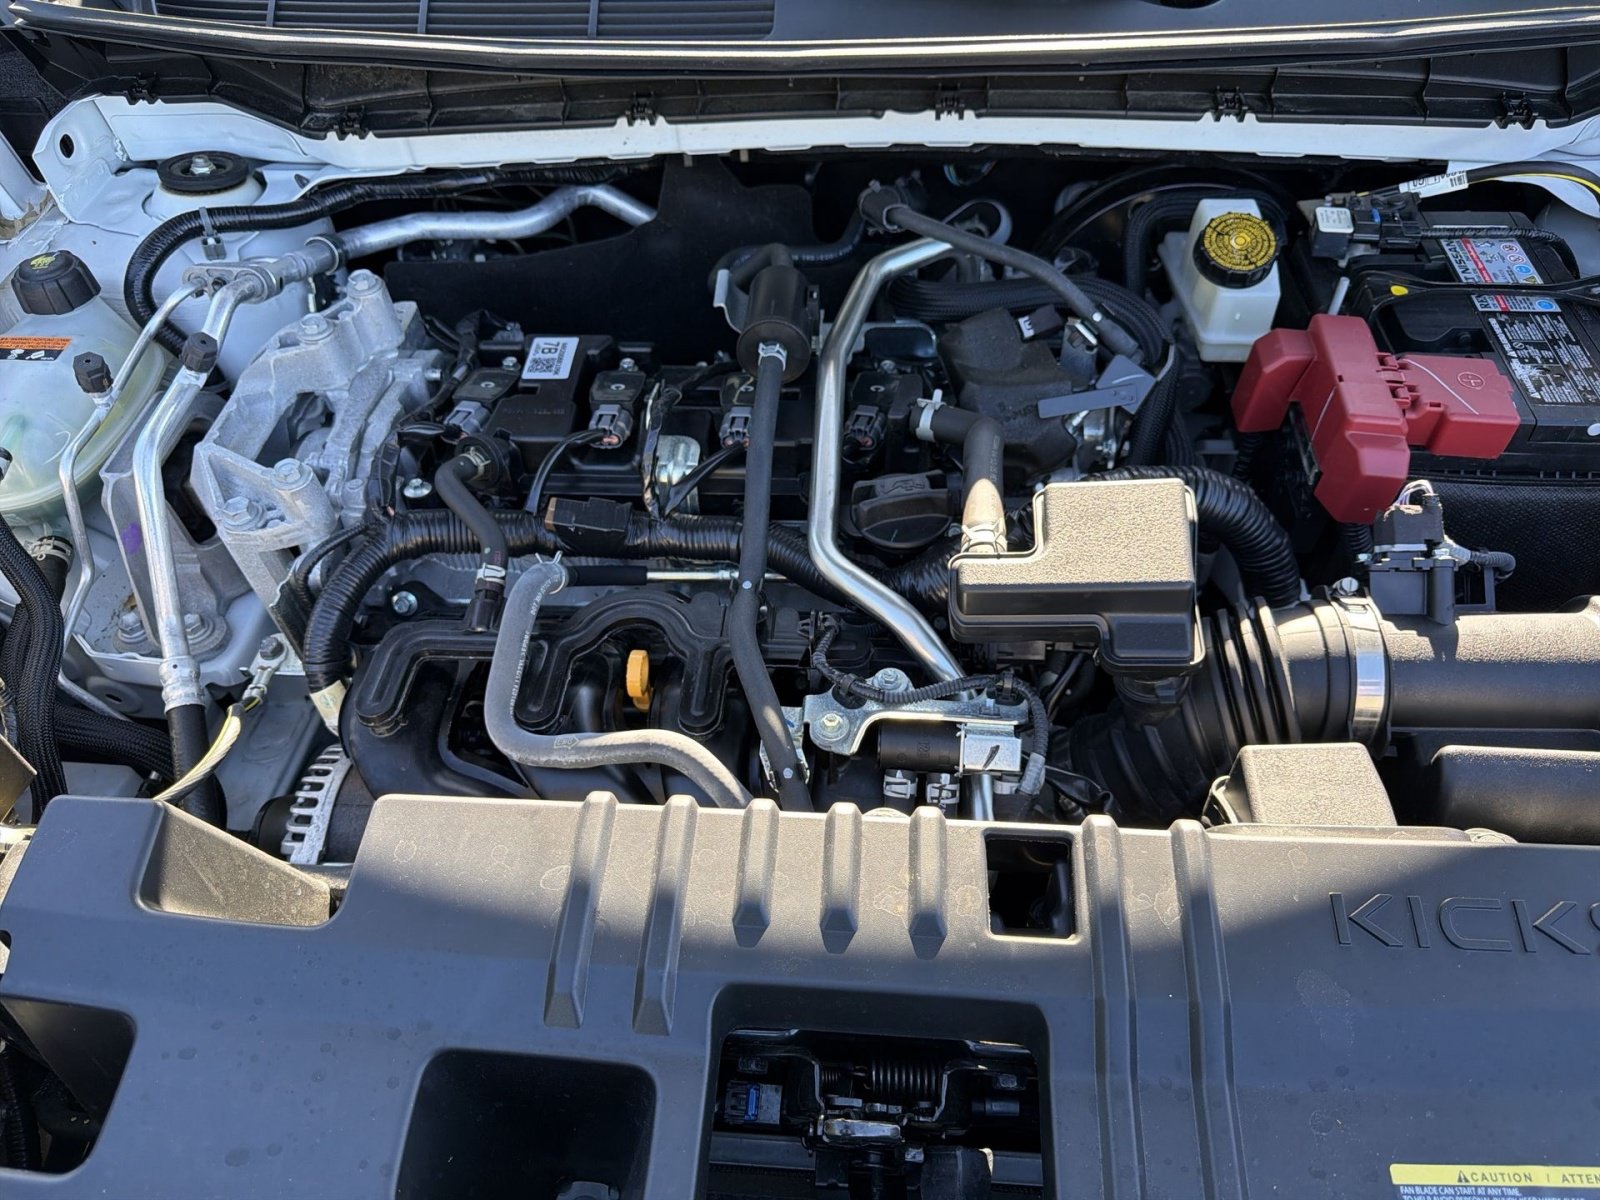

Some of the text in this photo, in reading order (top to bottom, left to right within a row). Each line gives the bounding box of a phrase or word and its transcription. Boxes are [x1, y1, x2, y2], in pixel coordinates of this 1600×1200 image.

[1443, 240, 1472, 274] NISSAN
[541, 342, 560, 354] 7B
[1328, 892, 1600, 955] KICK
[1470, 1172, 1533, 1183] CAUTION
[1400, 1185, 1414, 1194] FAN
[1415, 1185, 1438, 1195] BLADE
[1439, 1186, 1454, 1195] CAN
[1455, 1186, 1475, 1196] START
[1478, 1186, 1486, 1196] AT
[1487, 1187, 1502, 1196] ANY
